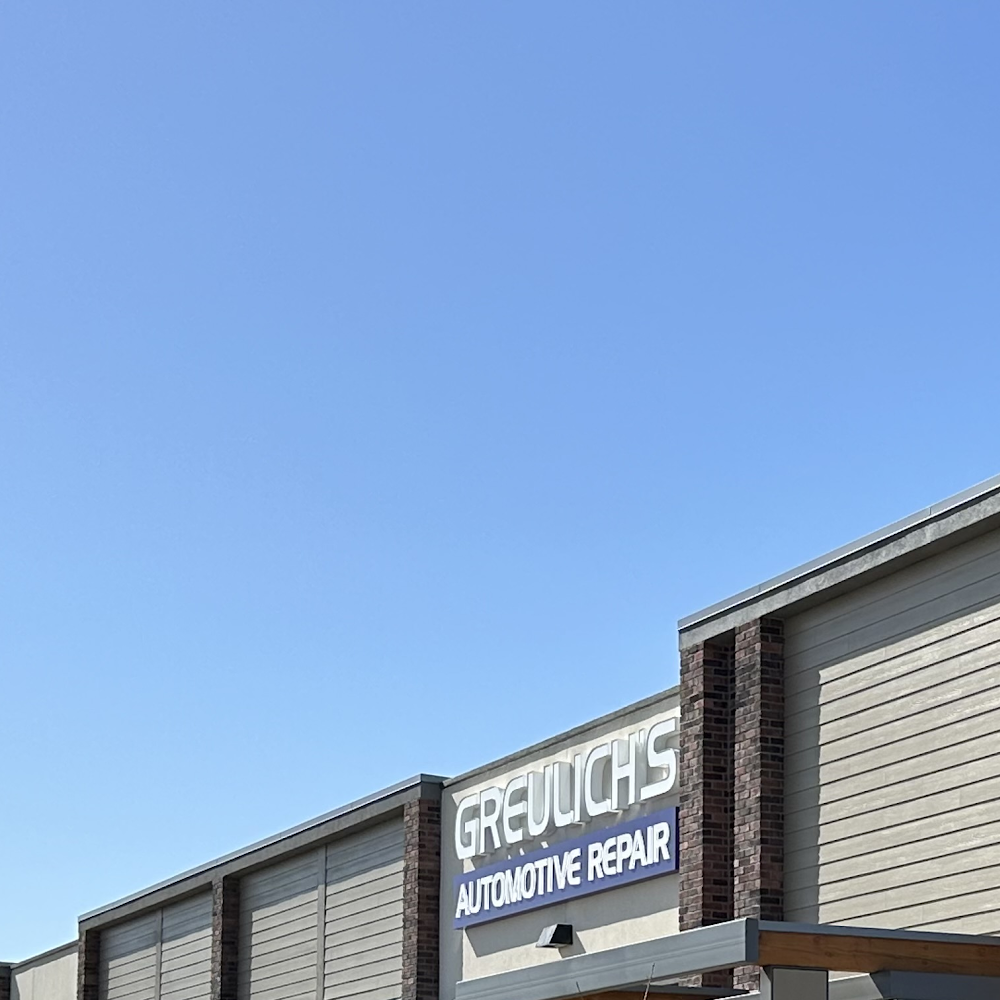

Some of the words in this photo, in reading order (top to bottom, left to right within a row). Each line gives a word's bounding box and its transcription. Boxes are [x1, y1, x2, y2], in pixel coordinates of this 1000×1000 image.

[455, 717, 680, 861] GREULICH'S
[455, 847, 582, 919] AUTOMOTIVE
[587, 821, 671, 883] REPAIR
